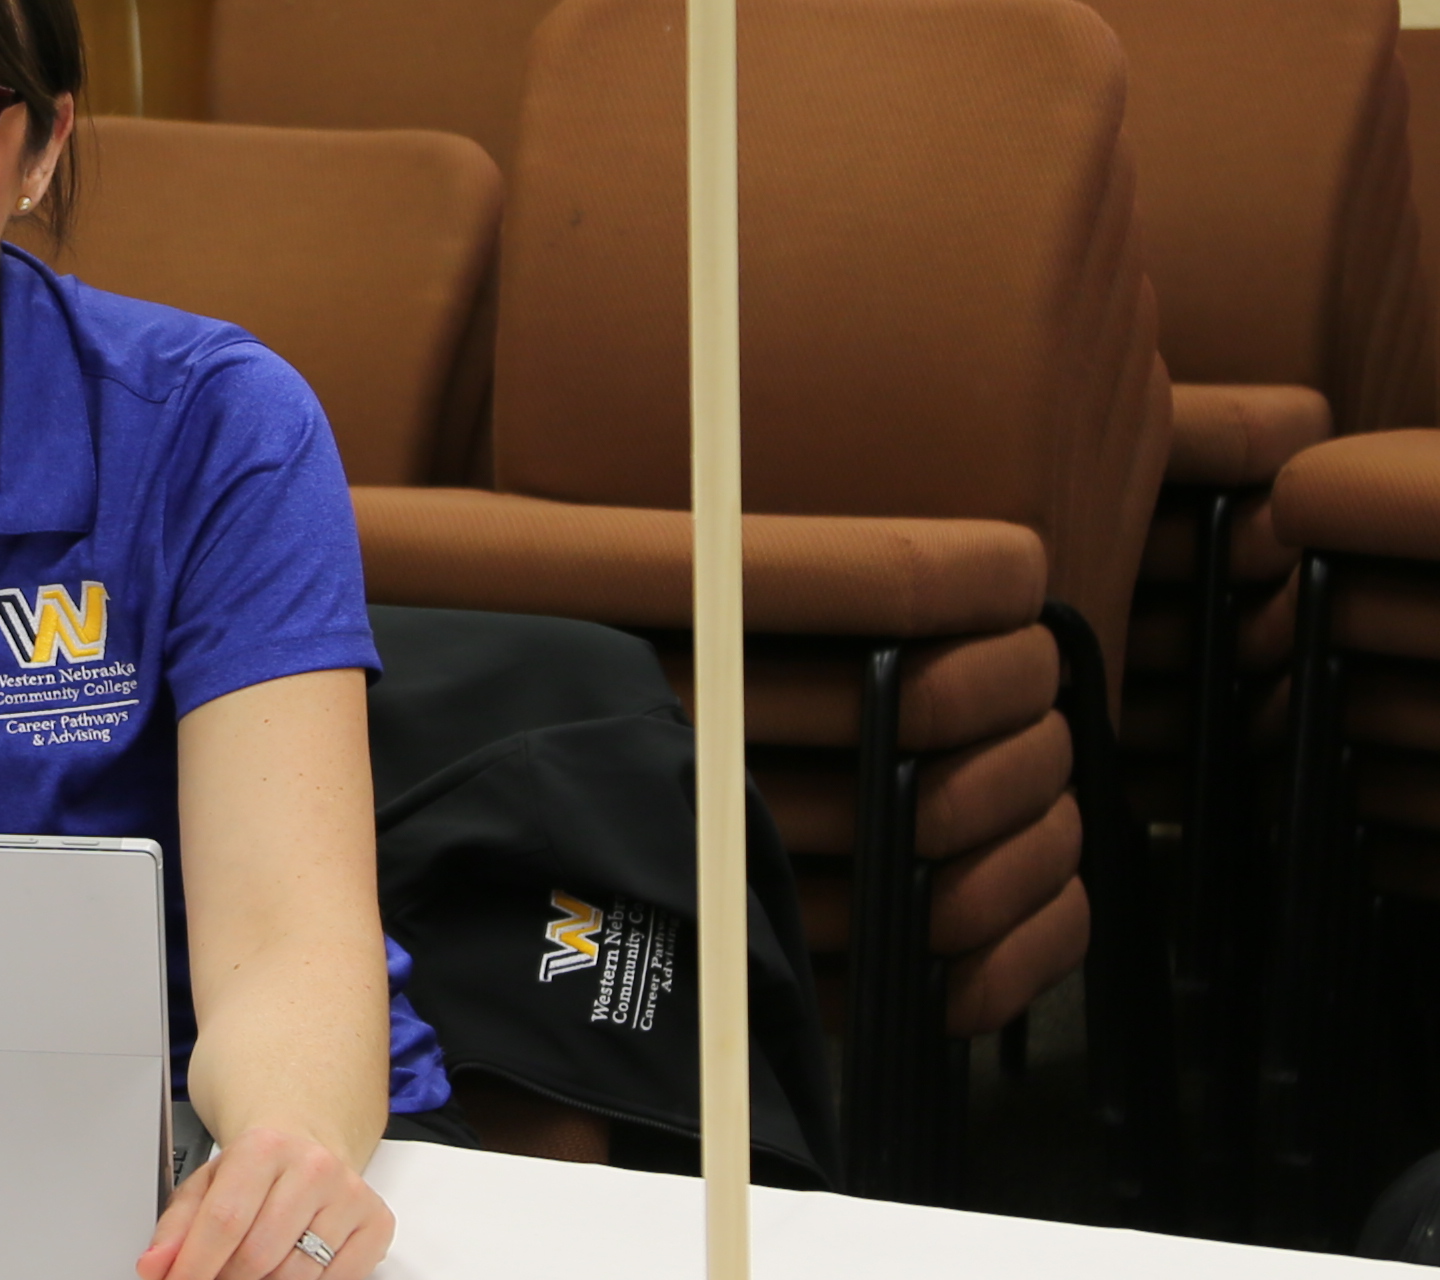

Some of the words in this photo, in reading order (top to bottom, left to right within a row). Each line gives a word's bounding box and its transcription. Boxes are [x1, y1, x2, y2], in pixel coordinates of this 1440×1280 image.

[59, 661, 136, 683] Nebraska
[84, 679, 137, 696] College
[7, 720, 56, 734] Career
[61, 711, 129, 730] Pathways
[33, 734, 45, 746] &
[48, 728, 111, 745] Advising
[604, 896, 626, 946] Nebr
[591, 949, 619, 1023] Western
[612, 927, 645, 1024] Community
[640, 974, 661, 1031] Career
